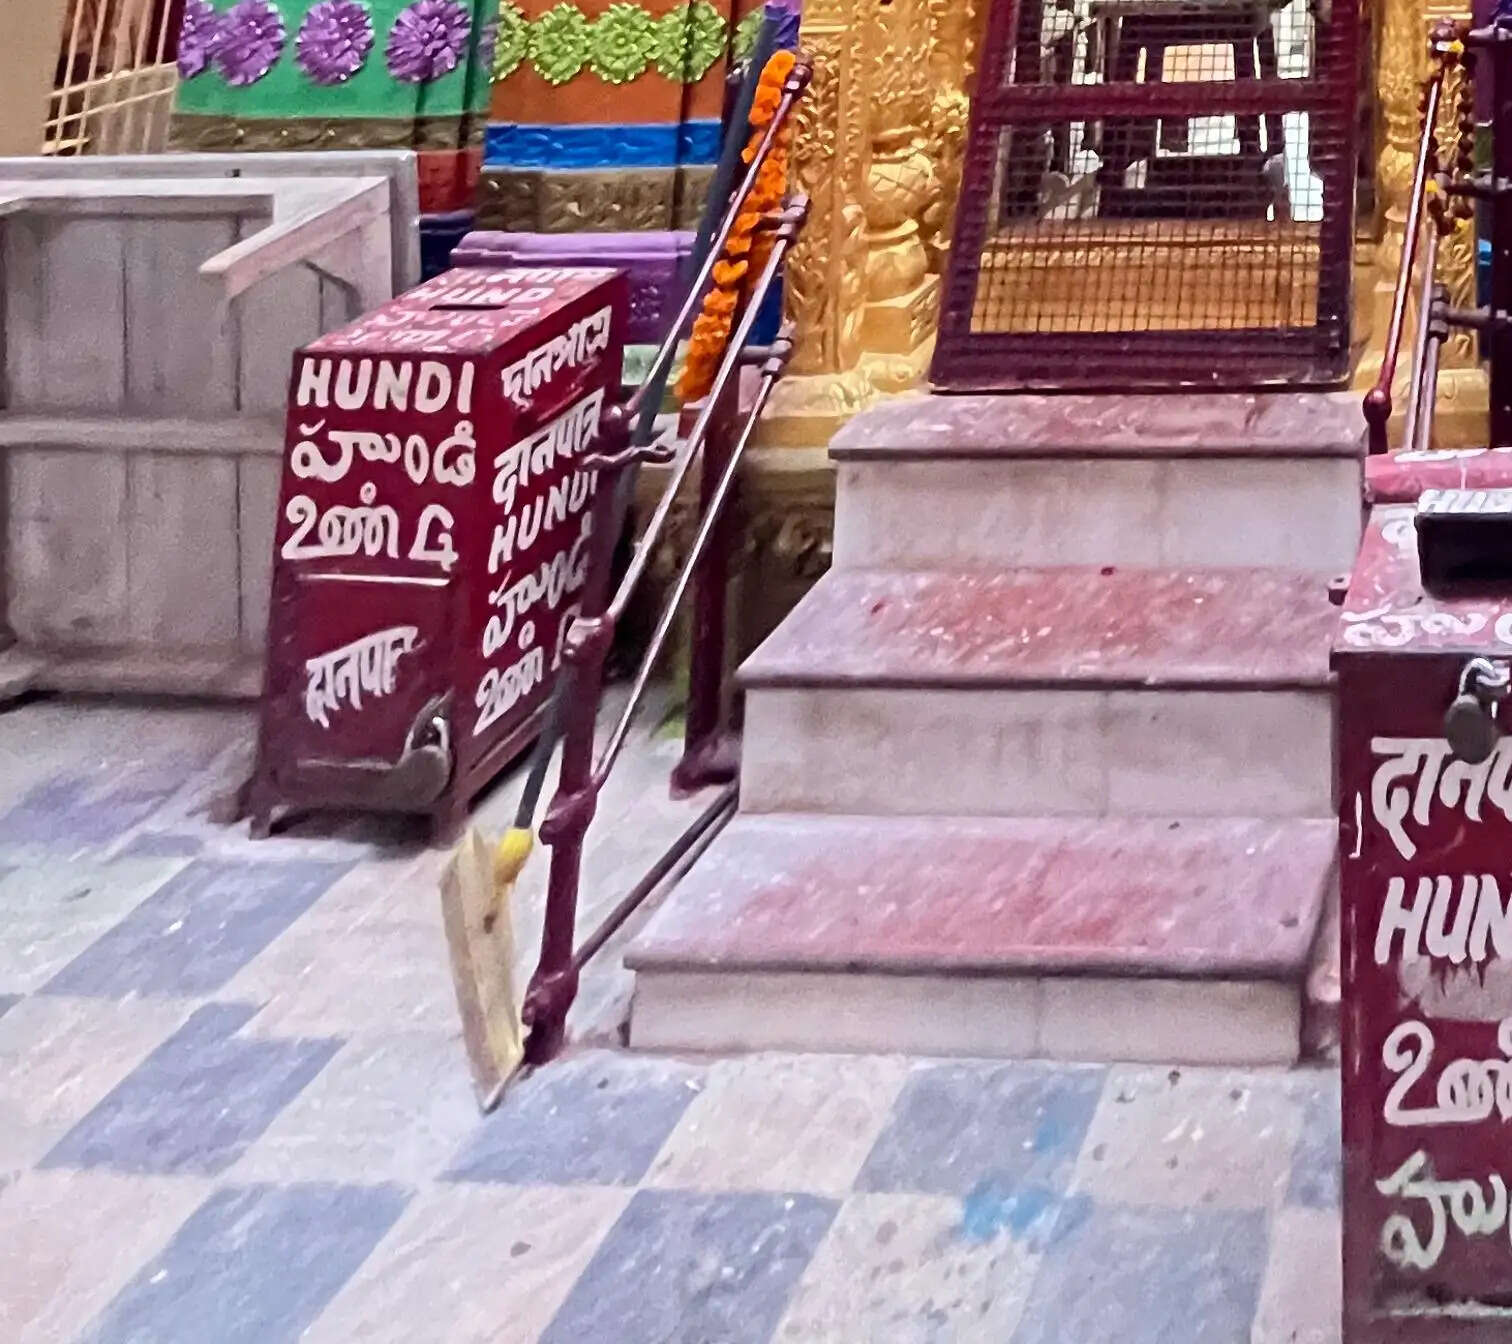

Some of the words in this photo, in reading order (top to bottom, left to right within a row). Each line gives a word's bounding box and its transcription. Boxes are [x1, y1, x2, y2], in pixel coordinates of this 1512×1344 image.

[297, 358, 475, 413] HUNDI
[492, 386, 605, 515] दानपात्र
[487, 469, 599, 575] HUNDI
